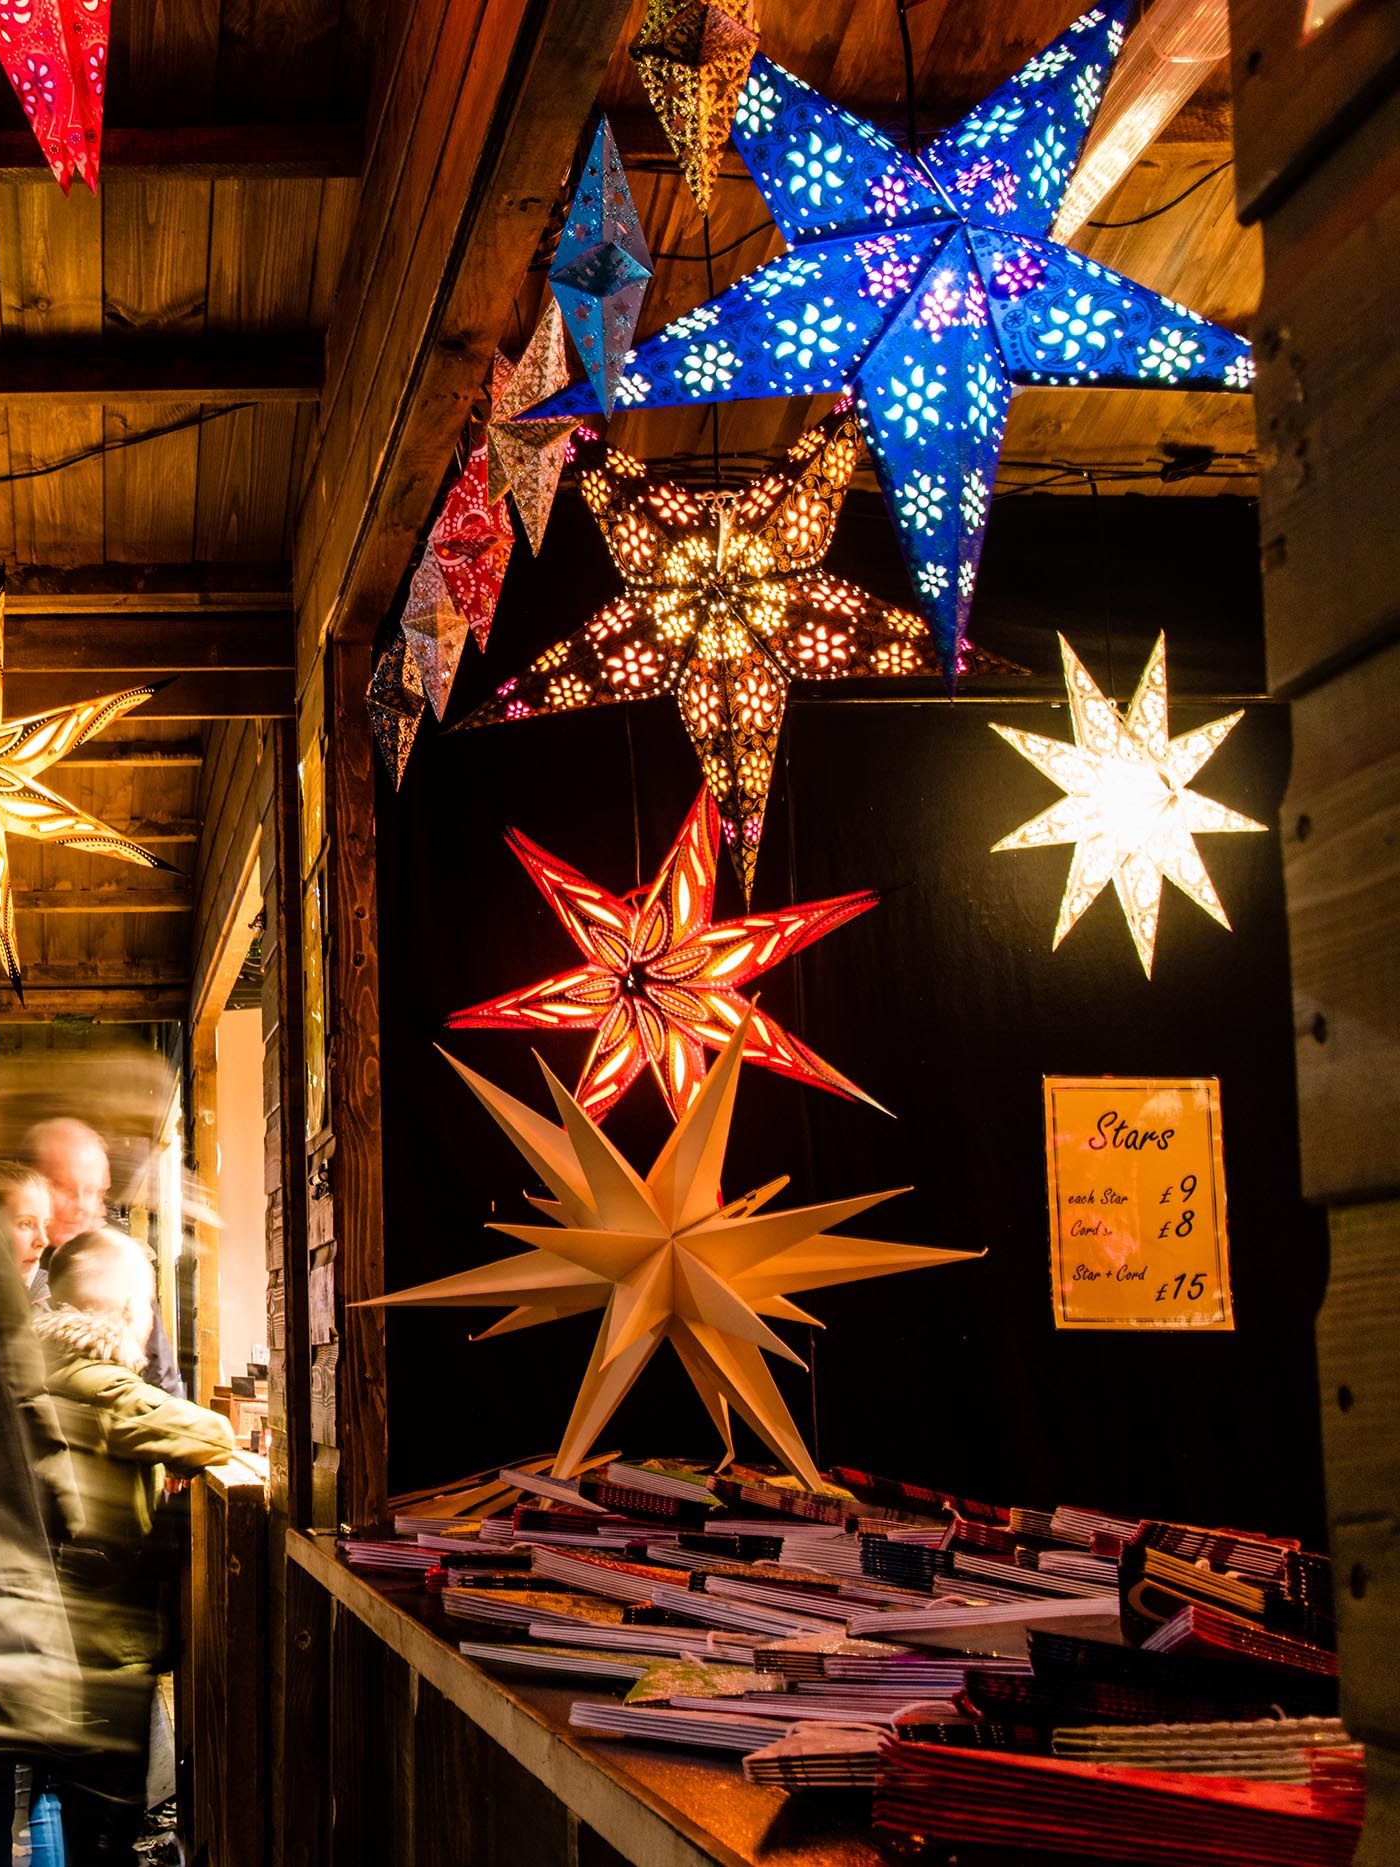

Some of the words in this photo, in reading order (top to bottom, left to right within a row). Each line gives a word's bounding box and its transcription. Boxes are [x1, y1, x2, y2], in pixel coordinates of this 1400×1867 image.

[1088, 1111, 1175, 1151] Stars
[1068, 1189, 1095, 1205] each
[1100, 1188, 1128, 1205] Star
[1159, 1174, 1197, 1205] £9
[1070, 1220, 1102, 1237] Cord
[1158, 1210, 1195, 1239] £8
[1073, 1264, 1101, 1281] Star
[1104, 1270, 1113, 1279] +
[1116, 1265, 1148, 1282] Cord
[1155, 1272, 1208, 1302] £15
